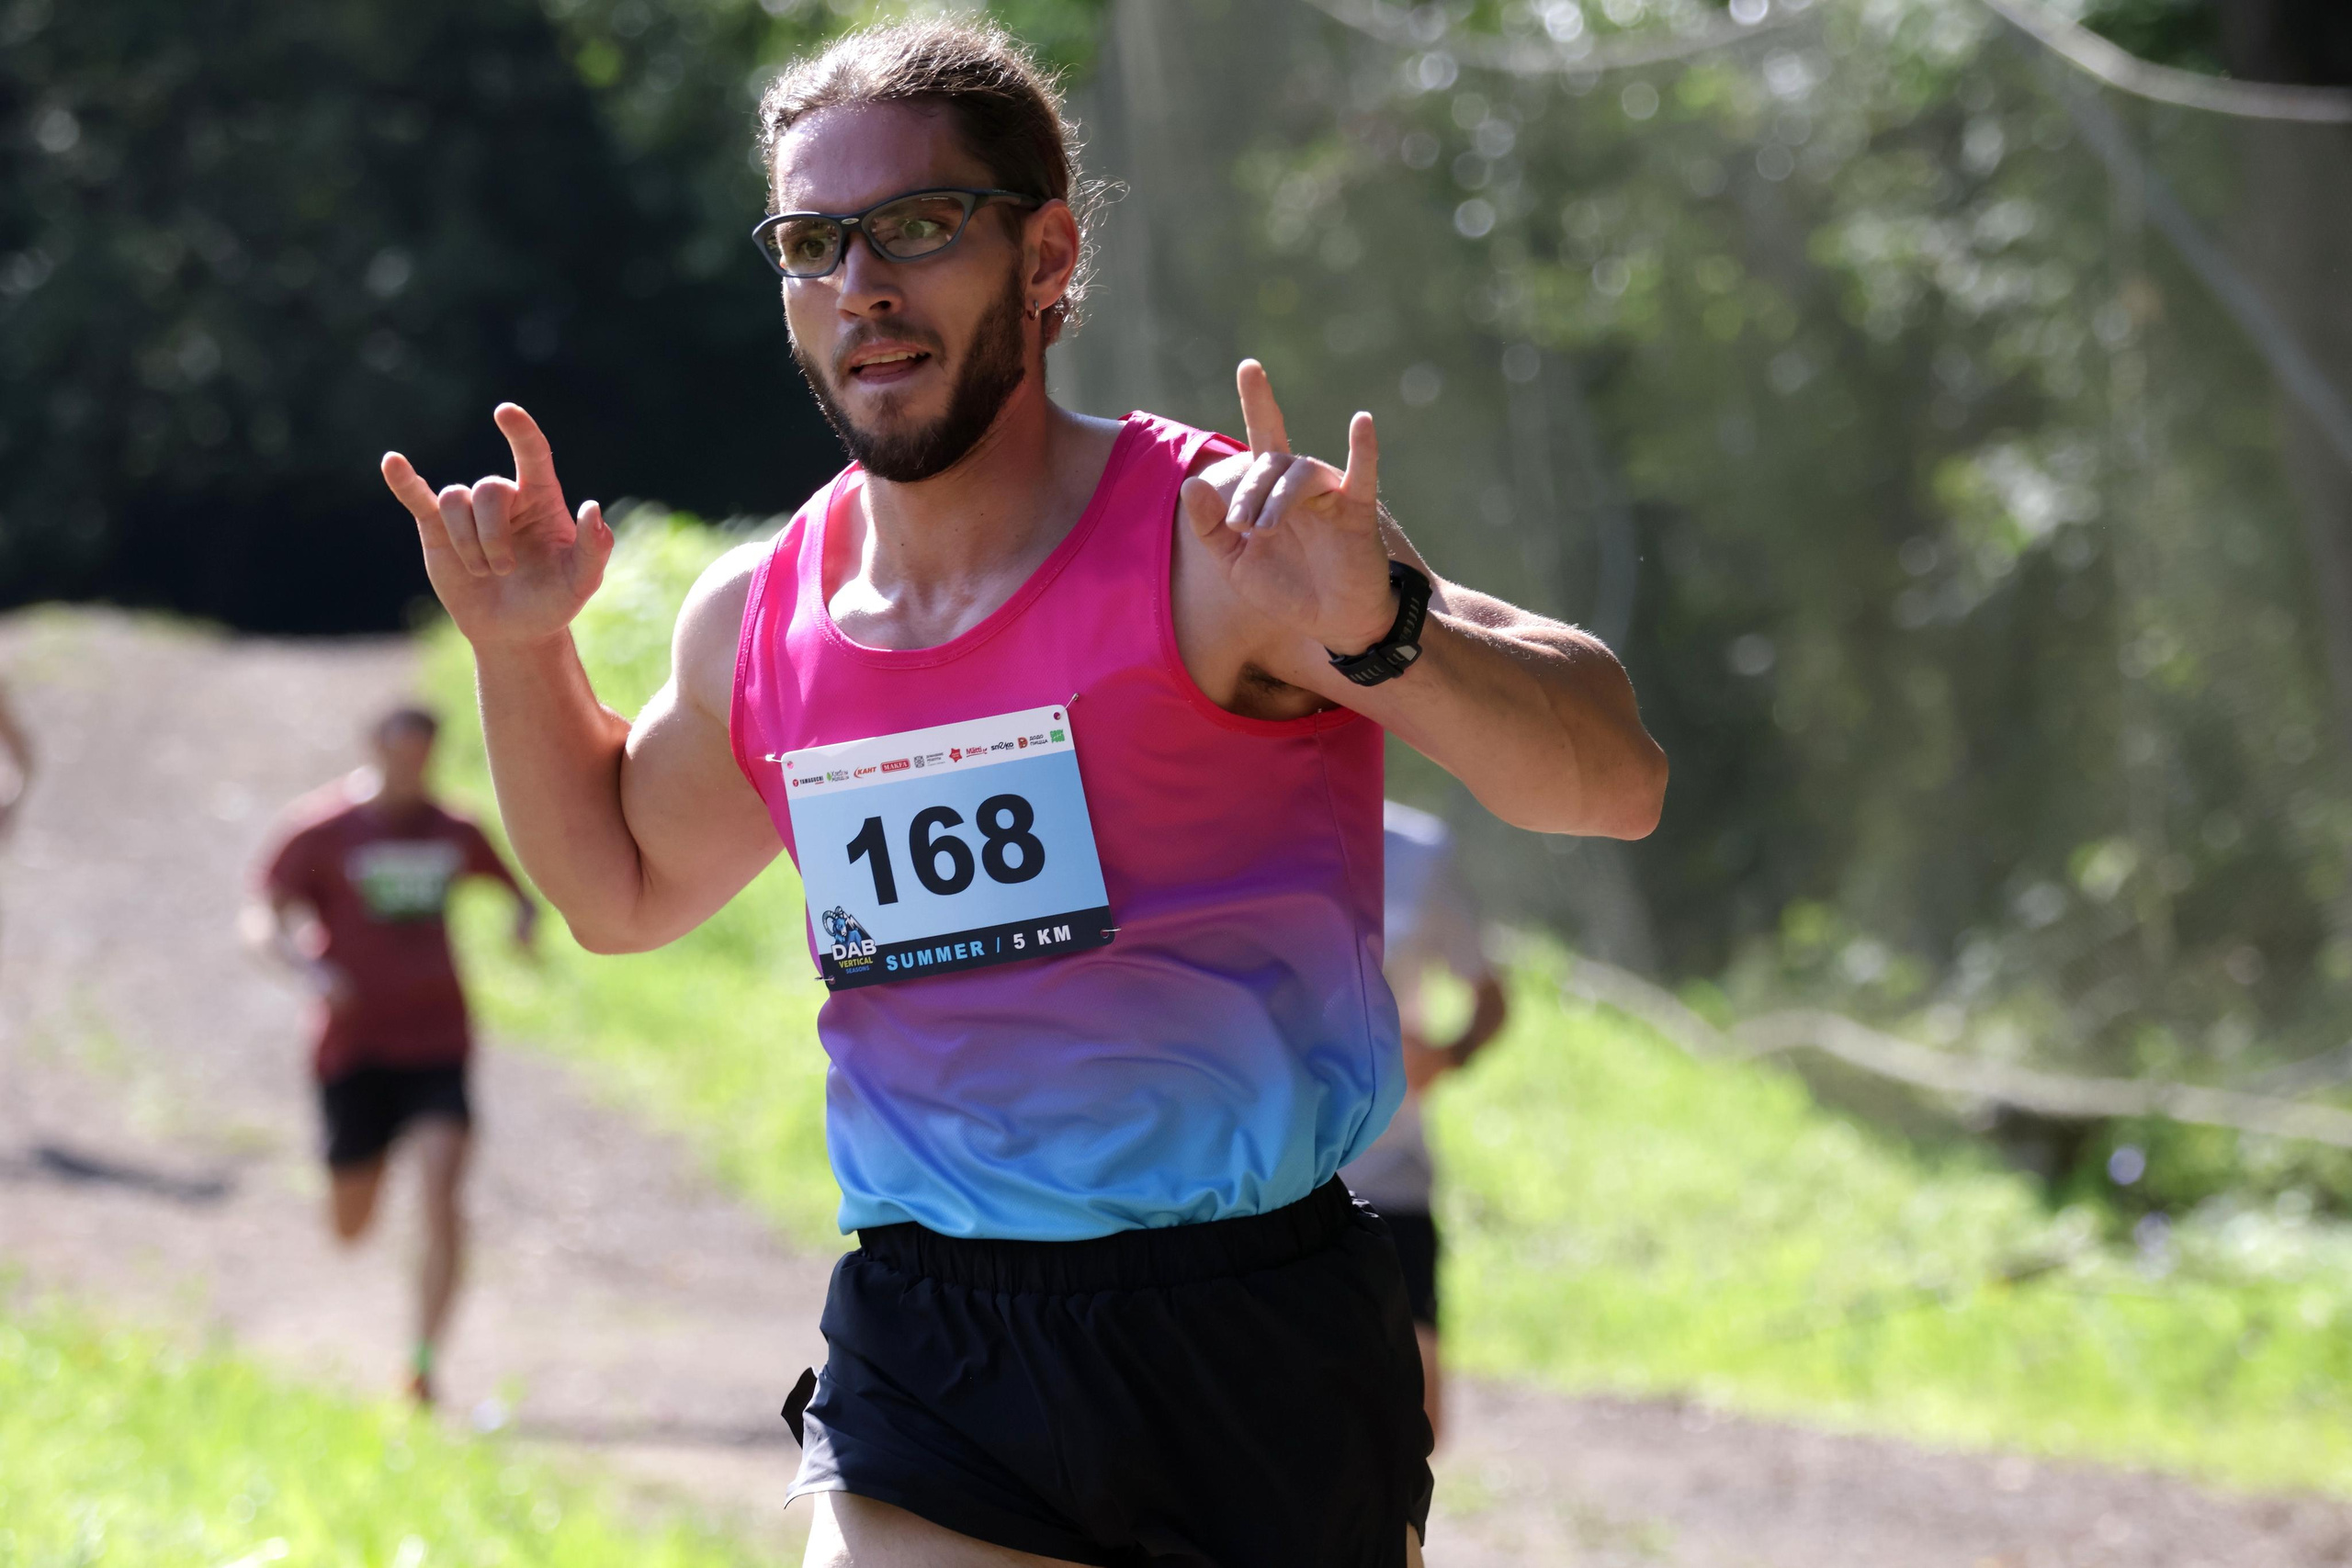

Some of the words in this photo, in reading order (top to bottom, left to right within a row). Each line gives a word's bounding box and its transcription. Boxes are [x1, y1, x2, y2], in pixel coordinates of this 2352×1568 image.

[799, 775, 823, 784] YAMAGUCHI
[846, 794, 1046, 906] 168
[831, 939, 877, 961] DAB
[886, 941, 985, 971] SUMMER
[1012, 933, 1026, 950] 5
[1037, 925, 1071, 946] KM
[839, 956, 873, 968] VERTICAL
[845, 964, 870, 974] SEASONS
